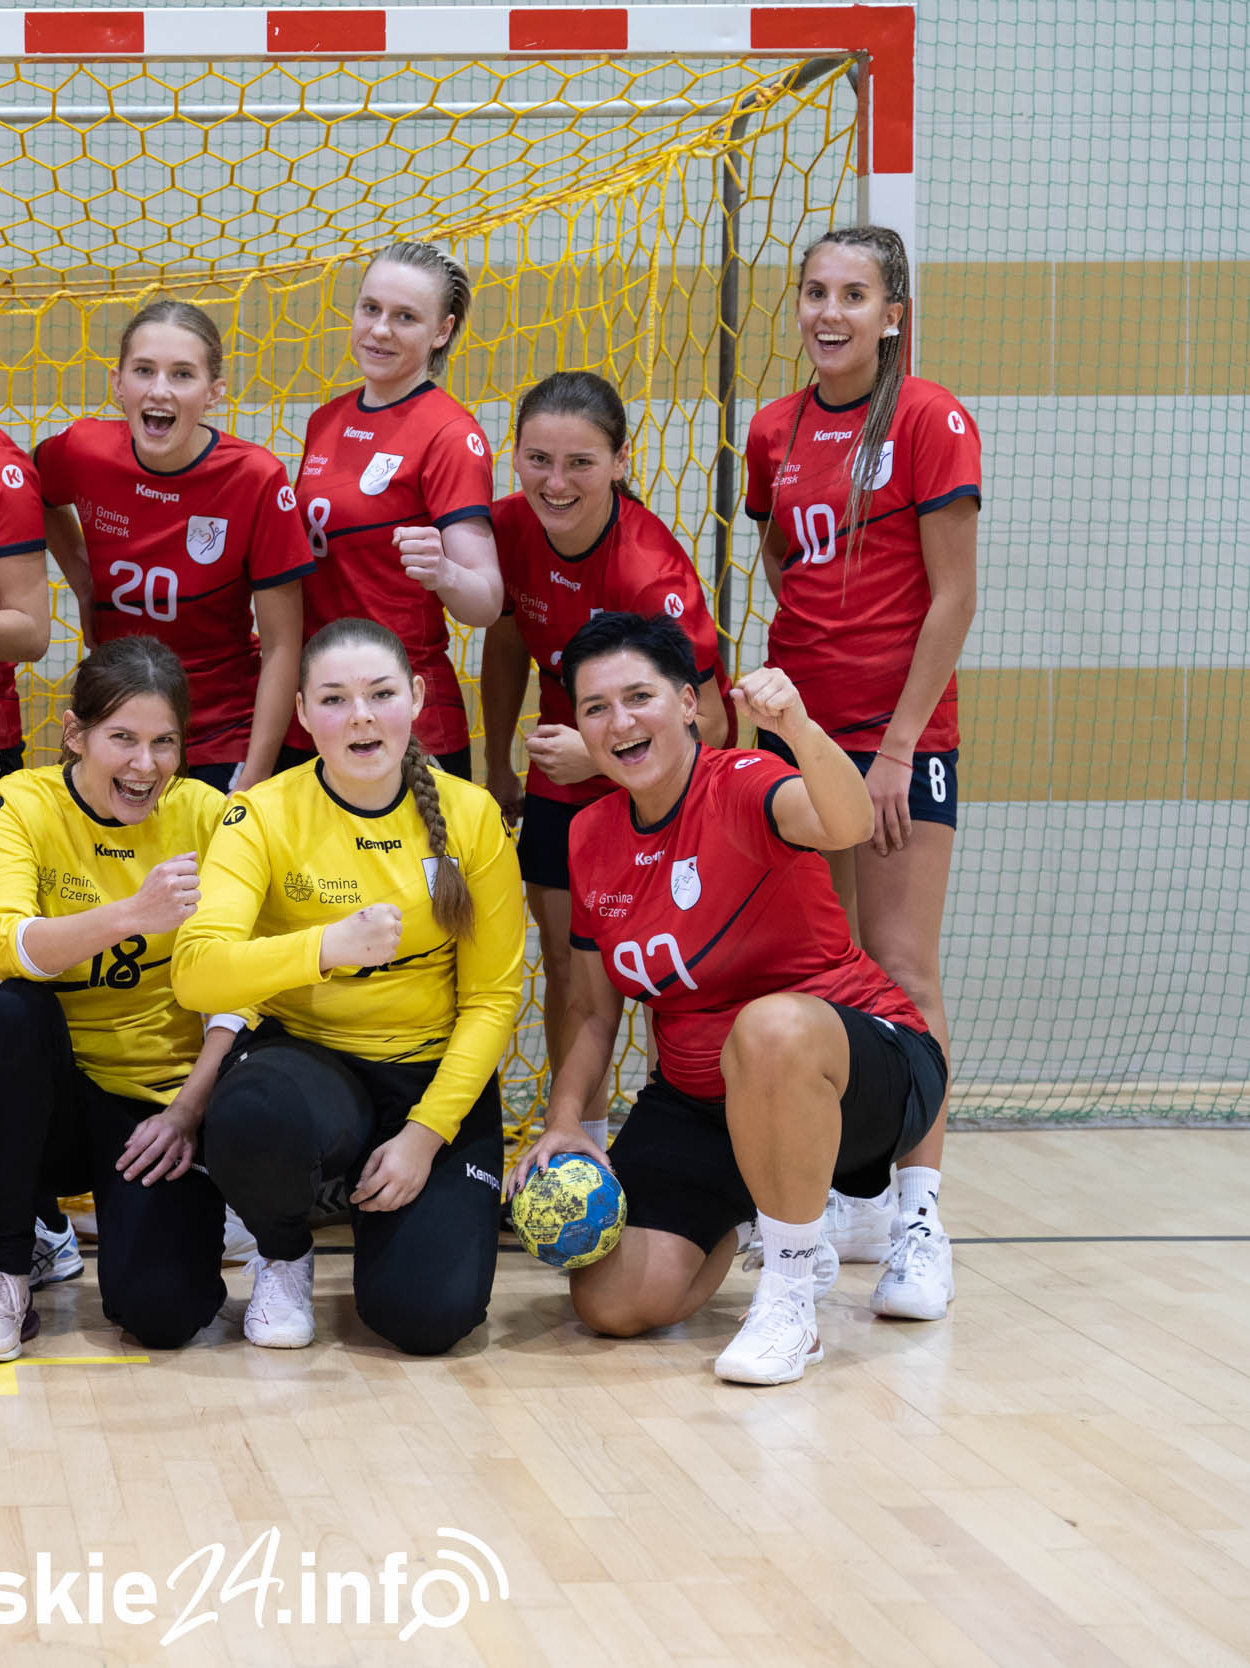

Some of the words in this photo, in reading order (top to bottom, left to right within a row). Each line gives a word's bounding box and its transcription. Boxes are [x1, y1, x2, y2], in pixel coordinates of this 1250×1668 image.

[343, 426, 374, 442] Kempa
[814, 430, 853, 443] Kempa
[136, 483, 180, 503] Kempa
[96, 506, 129, 525] Gmina
[95, 519, 130, 538] Czersk
[793, 503, 836, 564] 10
[110, 560, 178, 622] 20
[929, 757, 946, 803] 8
[94, 843, 135, 861] Kempa
[356, 837, 402, 853] Kempa
[62, 873, 96, 890] Gmin
[318, 878, 358, 890] Gmina
[60, 887, 101, 904] Czersk
[319, 892, 362, 905] Czersk
[599, 892, 633, 905] Gmina
[599, 906, 627, 918] Czers
[614, 933, 698, 996] 97
